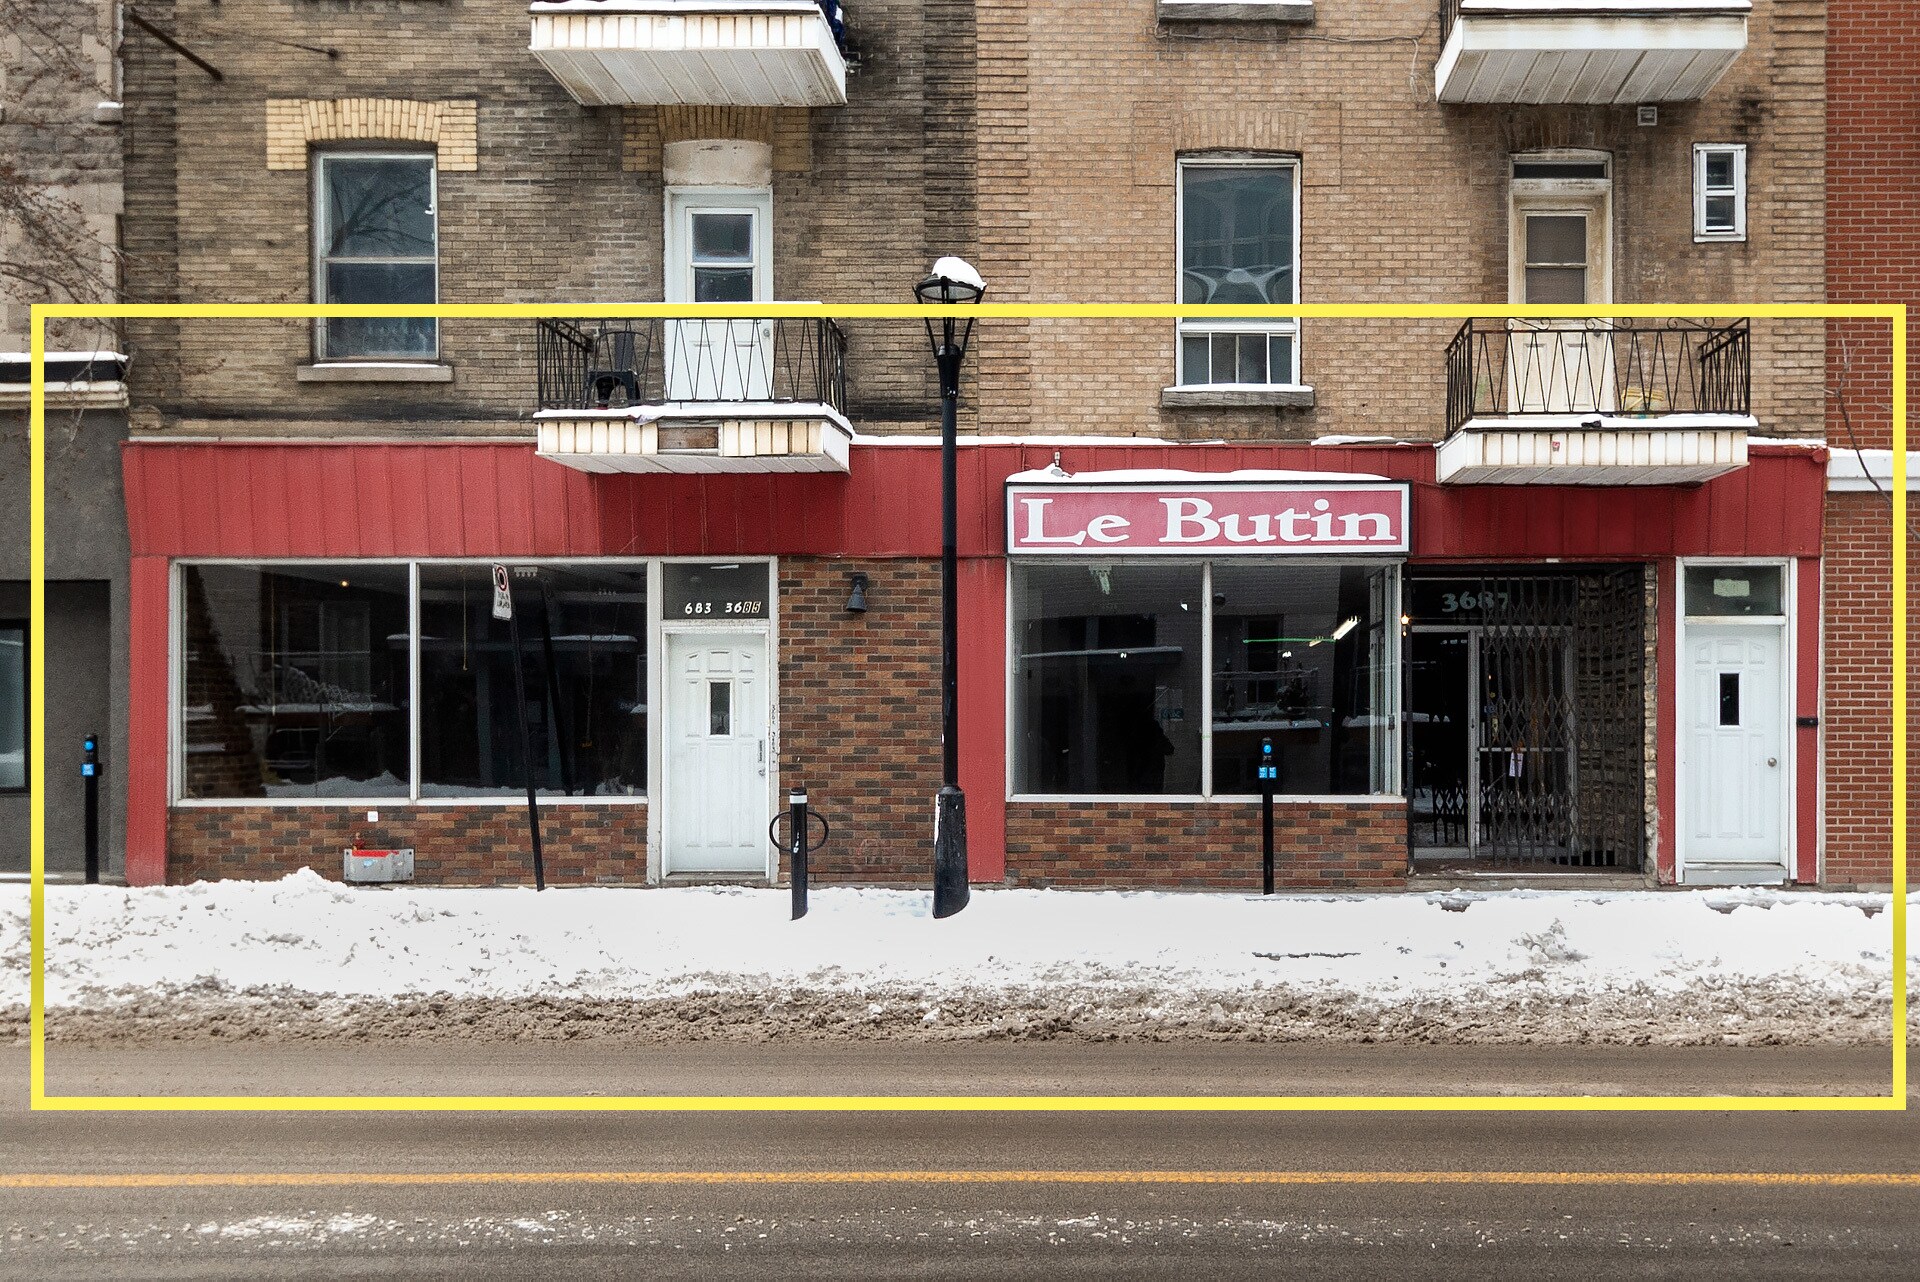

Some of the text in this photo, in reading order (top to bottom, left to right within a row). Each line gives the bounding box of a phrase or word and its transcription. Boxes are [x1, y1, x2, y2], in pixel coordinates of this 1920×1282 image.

[1020, 497, 1397, 545] Le Butin
[684, 601, 761, 614] 683 3685
[1441, 591, 1508, 612] 3687
